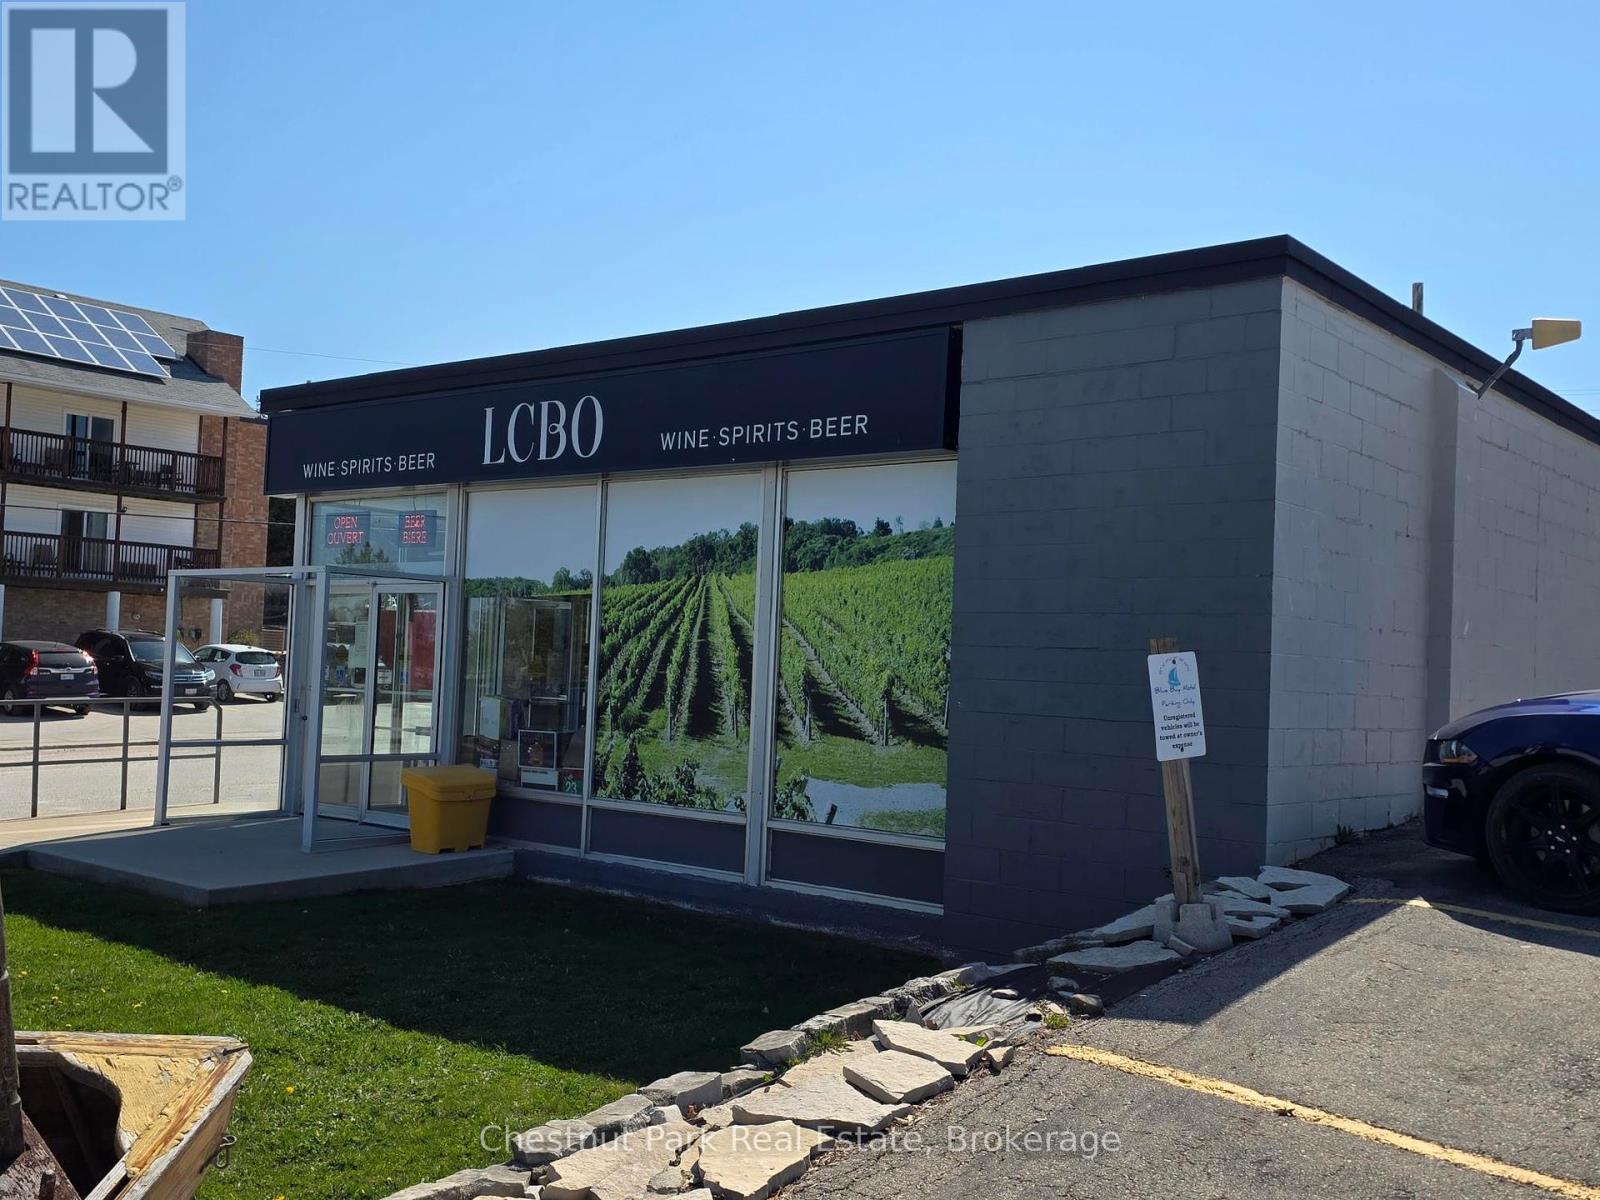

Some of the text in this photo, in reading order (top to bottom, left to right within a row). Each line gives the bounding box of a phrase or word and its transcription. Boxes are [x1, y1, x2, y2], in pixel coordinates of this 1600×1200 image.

[482, 395, 604, 465] LCBO
[333, 515, 358, 529] OPEN
[404, 514, 426, 529] BEER
[327, 531, 364, 545] OUVERT
[1163, 712, 1196, 721] Unregistered
[1160, 723, 1183, 731] vehicles
[1159, 733, 1176, 741] towed
[1183, 730, 1203, 738] owner's
